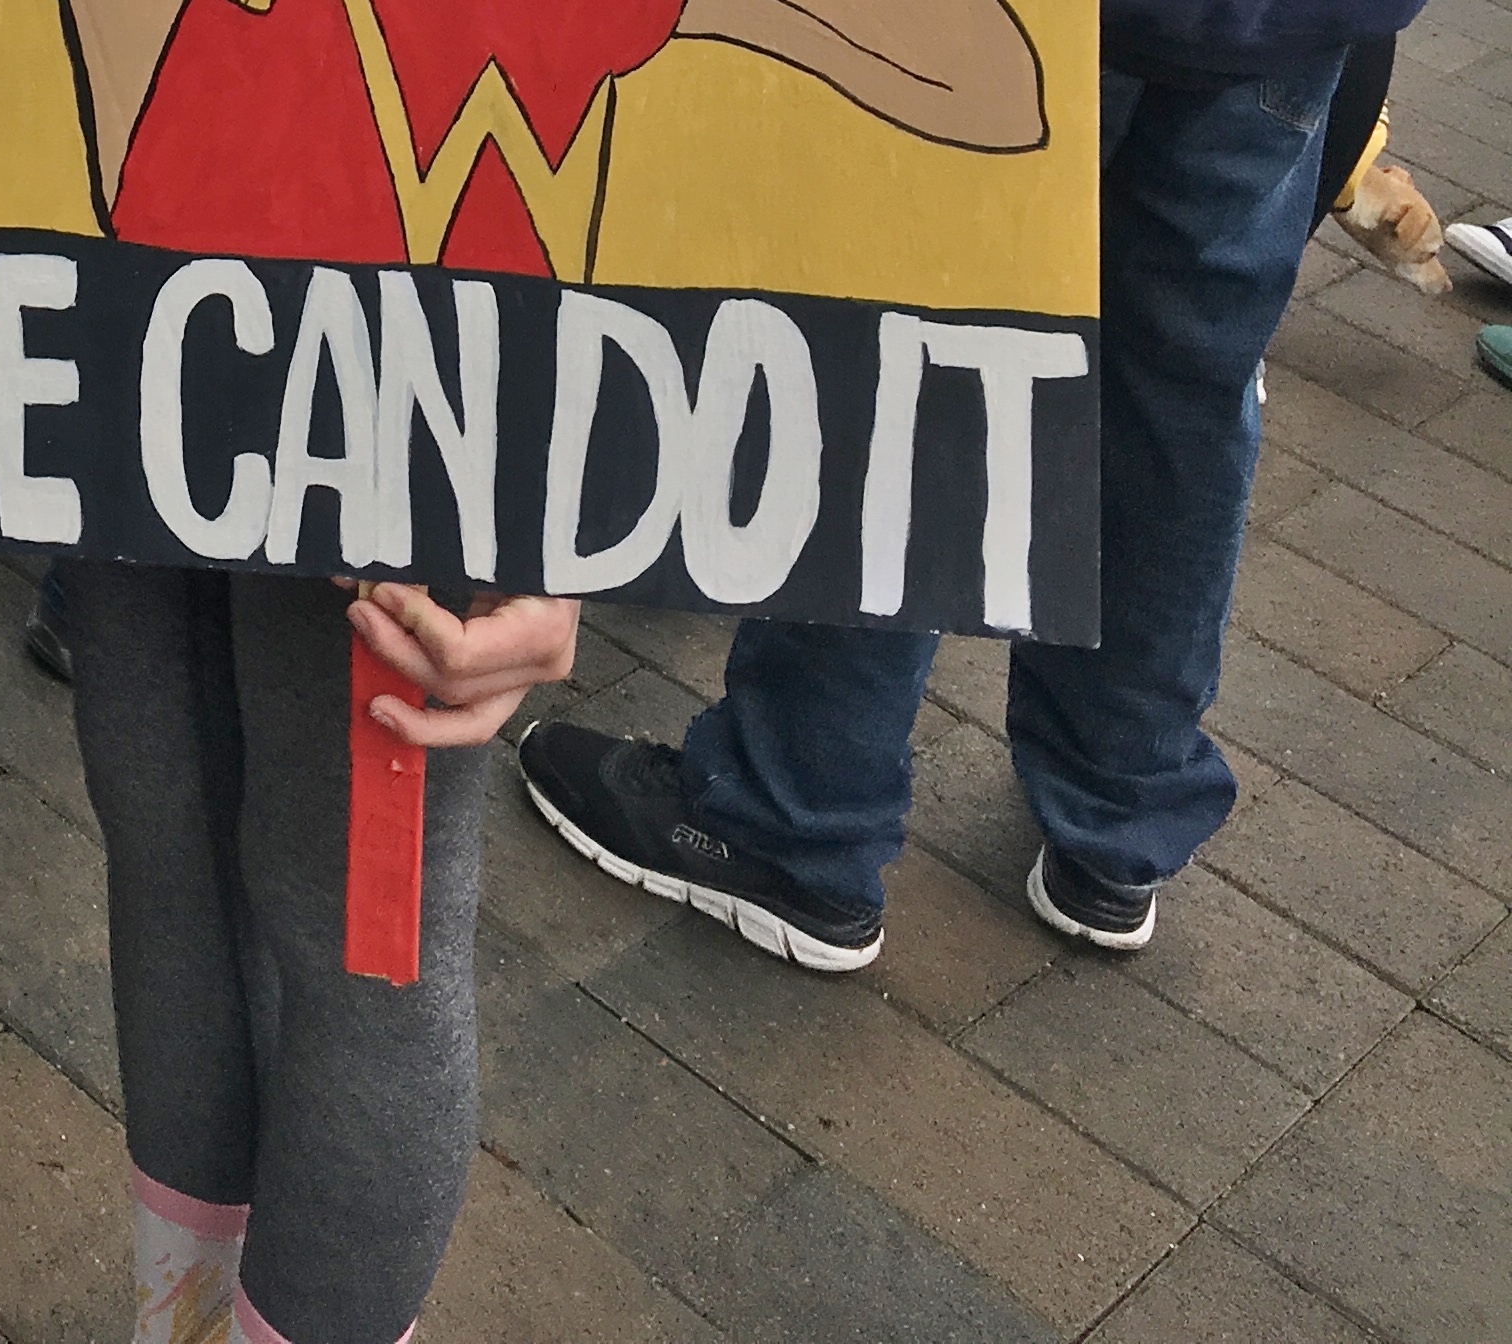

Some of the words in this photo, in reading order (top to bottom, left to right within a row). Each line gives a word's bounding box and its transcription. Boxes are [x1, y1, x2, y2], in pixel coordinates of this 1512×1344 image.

[140, 258, 500, 584] CAN
[542, 289, 824, 604] DO
[859, 311, 1090, 630] IT
